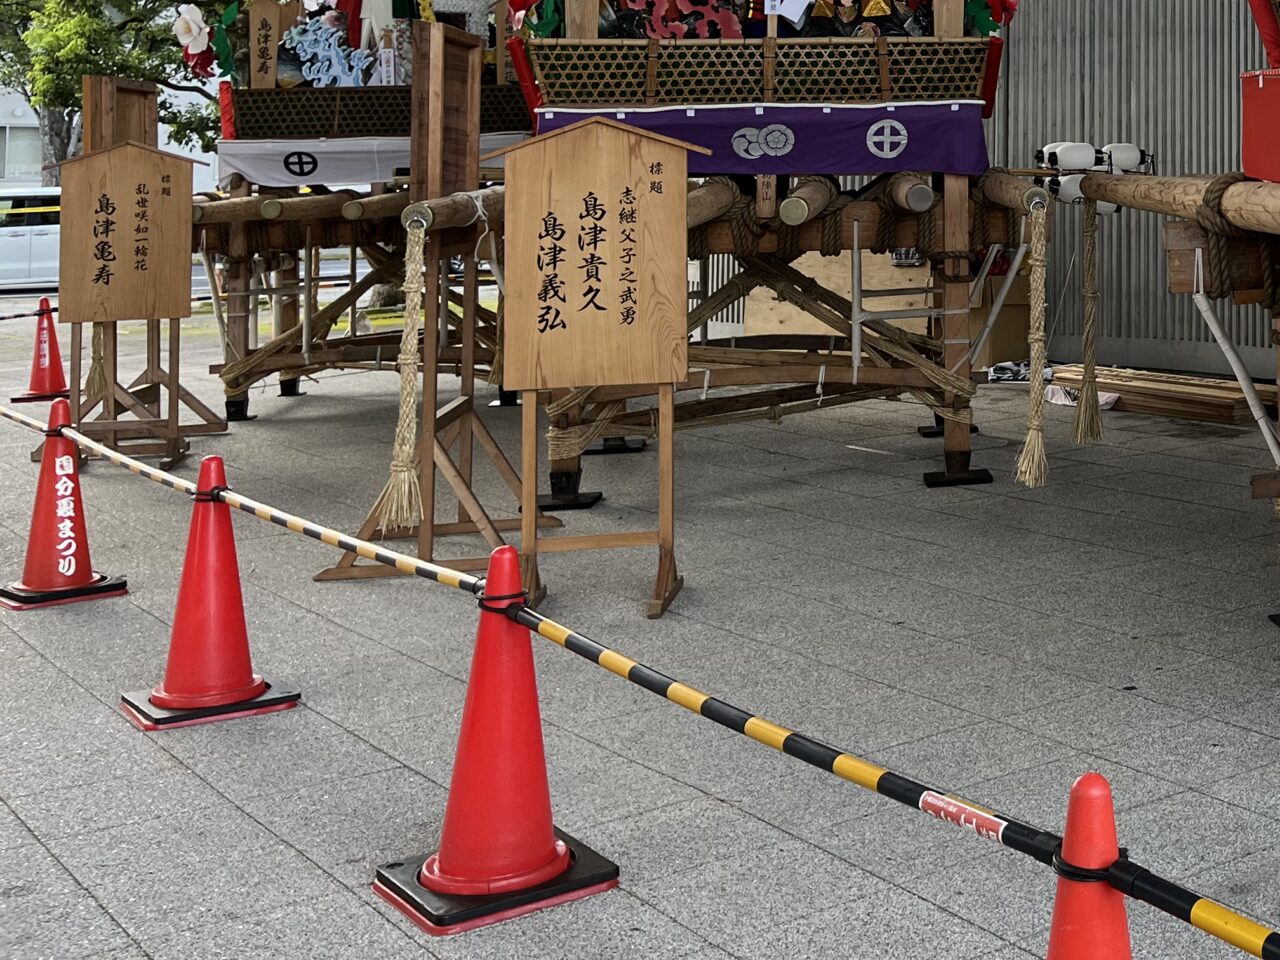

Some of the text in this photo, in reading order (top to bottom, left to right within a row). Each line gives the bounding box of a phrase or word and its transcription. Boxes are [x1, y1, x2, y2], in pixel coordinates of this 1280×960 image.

[256, 18, 272, 75] 島津亀寿
[160, 174, 172, 197] 標題
[648, 161, 663, 195] 標題
[91, 194, 117, 286] 島津亀寿
[134, 183, 150, 271] 乱世咲如一輪花
[576, 191, 608, 312] 島津貴久
[618, 186, 638, 326] 志継父子之武勇
[536, 211, 567, 334] 島津義弘
